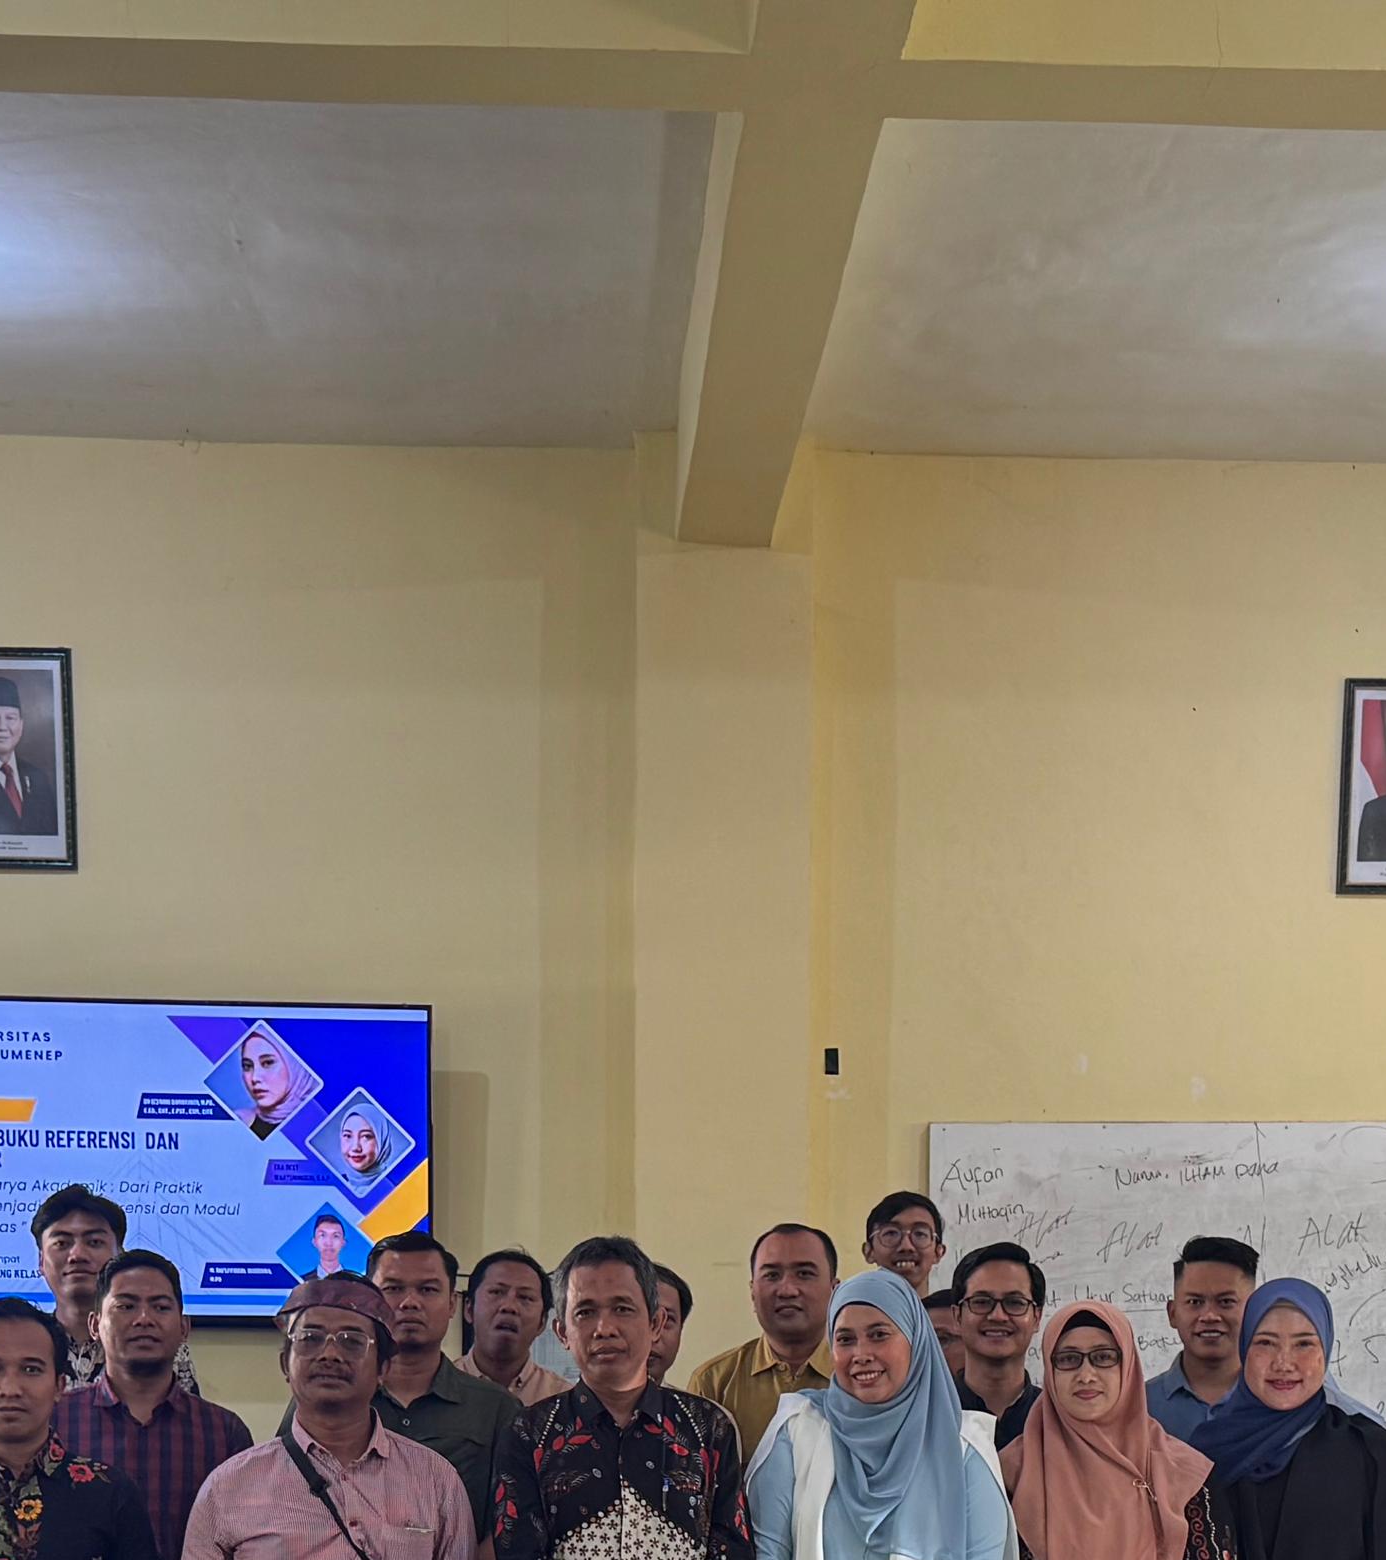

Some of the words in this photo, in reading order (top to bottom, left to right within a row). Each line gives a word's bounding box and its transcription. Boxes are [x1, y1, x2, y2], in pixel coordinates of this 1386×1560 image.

[45, 1130, 136, 1150] REFERENSI
[145, 1131, 180, 1150] DAN
[119, 1180, 150, 1194] Dari
[154, 1181, 203, 1195] Praktik
[160, 1203, 191, 1216] dan
[194, 1203, 241, 1217] Modul
